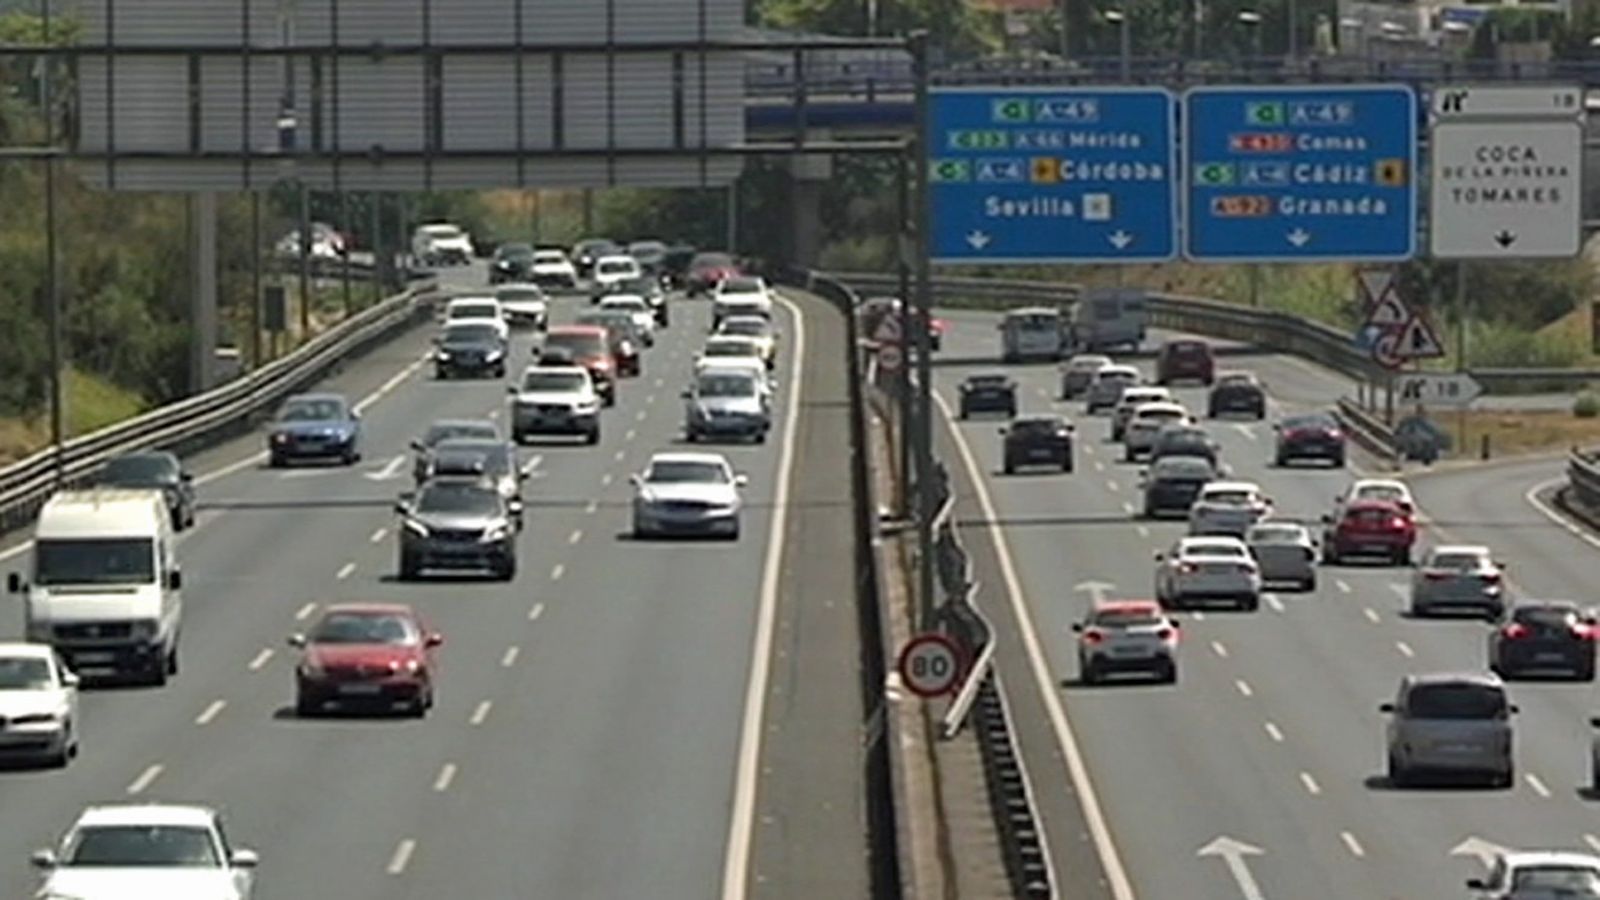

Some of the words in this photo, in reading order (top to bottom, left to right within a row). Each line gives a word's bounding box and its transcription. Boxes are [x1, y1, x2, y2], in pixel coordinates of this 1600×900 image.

[1070, 130, 1141, 148] Mérida
[1296, 134, 1367, 150] Camas
[1476, 146, 1537, 162] COCA
[1060, 160, 1164, 180] Córdoba
[1293, 163, 1367, 183] Cádiz
[1279, 196, 1387, 215] Granada
[1452, 188, 1560, 204] TOMARES
[985, 196, 1075, 216] Sevilla
[912, 655, 949, 678] 80
